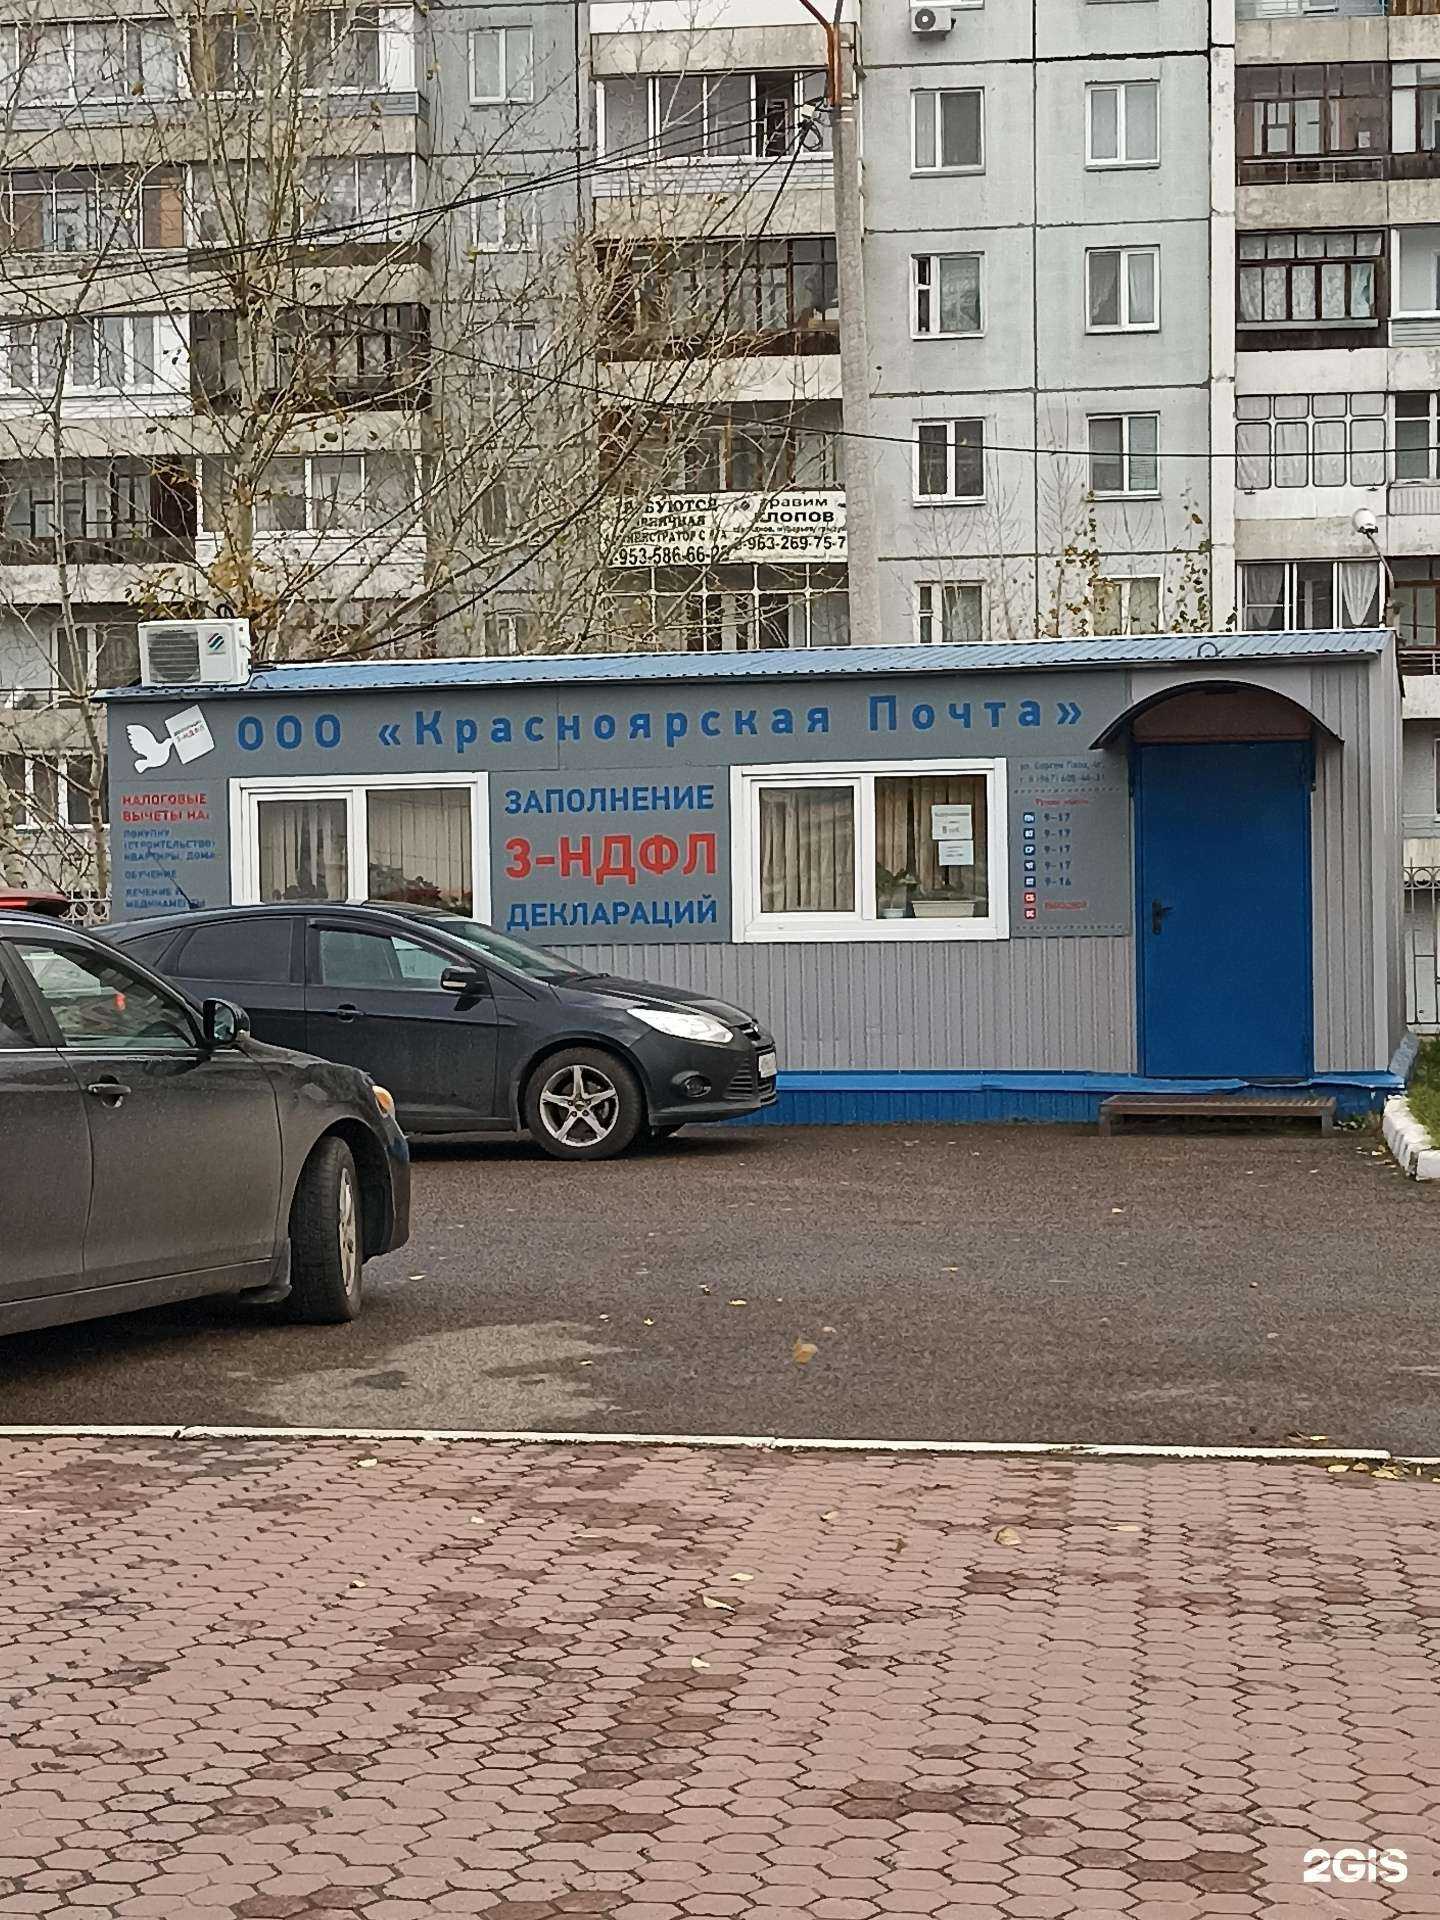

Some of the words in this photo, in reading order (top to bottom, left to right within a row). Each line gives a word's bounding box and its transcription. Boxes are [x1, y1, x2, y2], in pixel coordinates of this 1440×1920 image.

[762, 498, 828, 509] равим
[237, 713, 343, 751] ООО
[378, 707, 831, 754] «Красноярская
[868, 695, 1083, 732] Почта»
[122, 793, 207, 806] НАЛОГОВЫЕ
[505, 784, 714, 814] ЗАПОЛНЕНИЕ
[122, 810, 182, 822] ВЫЧЕТЫ
[505, 833, 716, 885] 3-НДФЛ
[506, 894, 717, 931] ДЕКЛАРАЦИЙ
